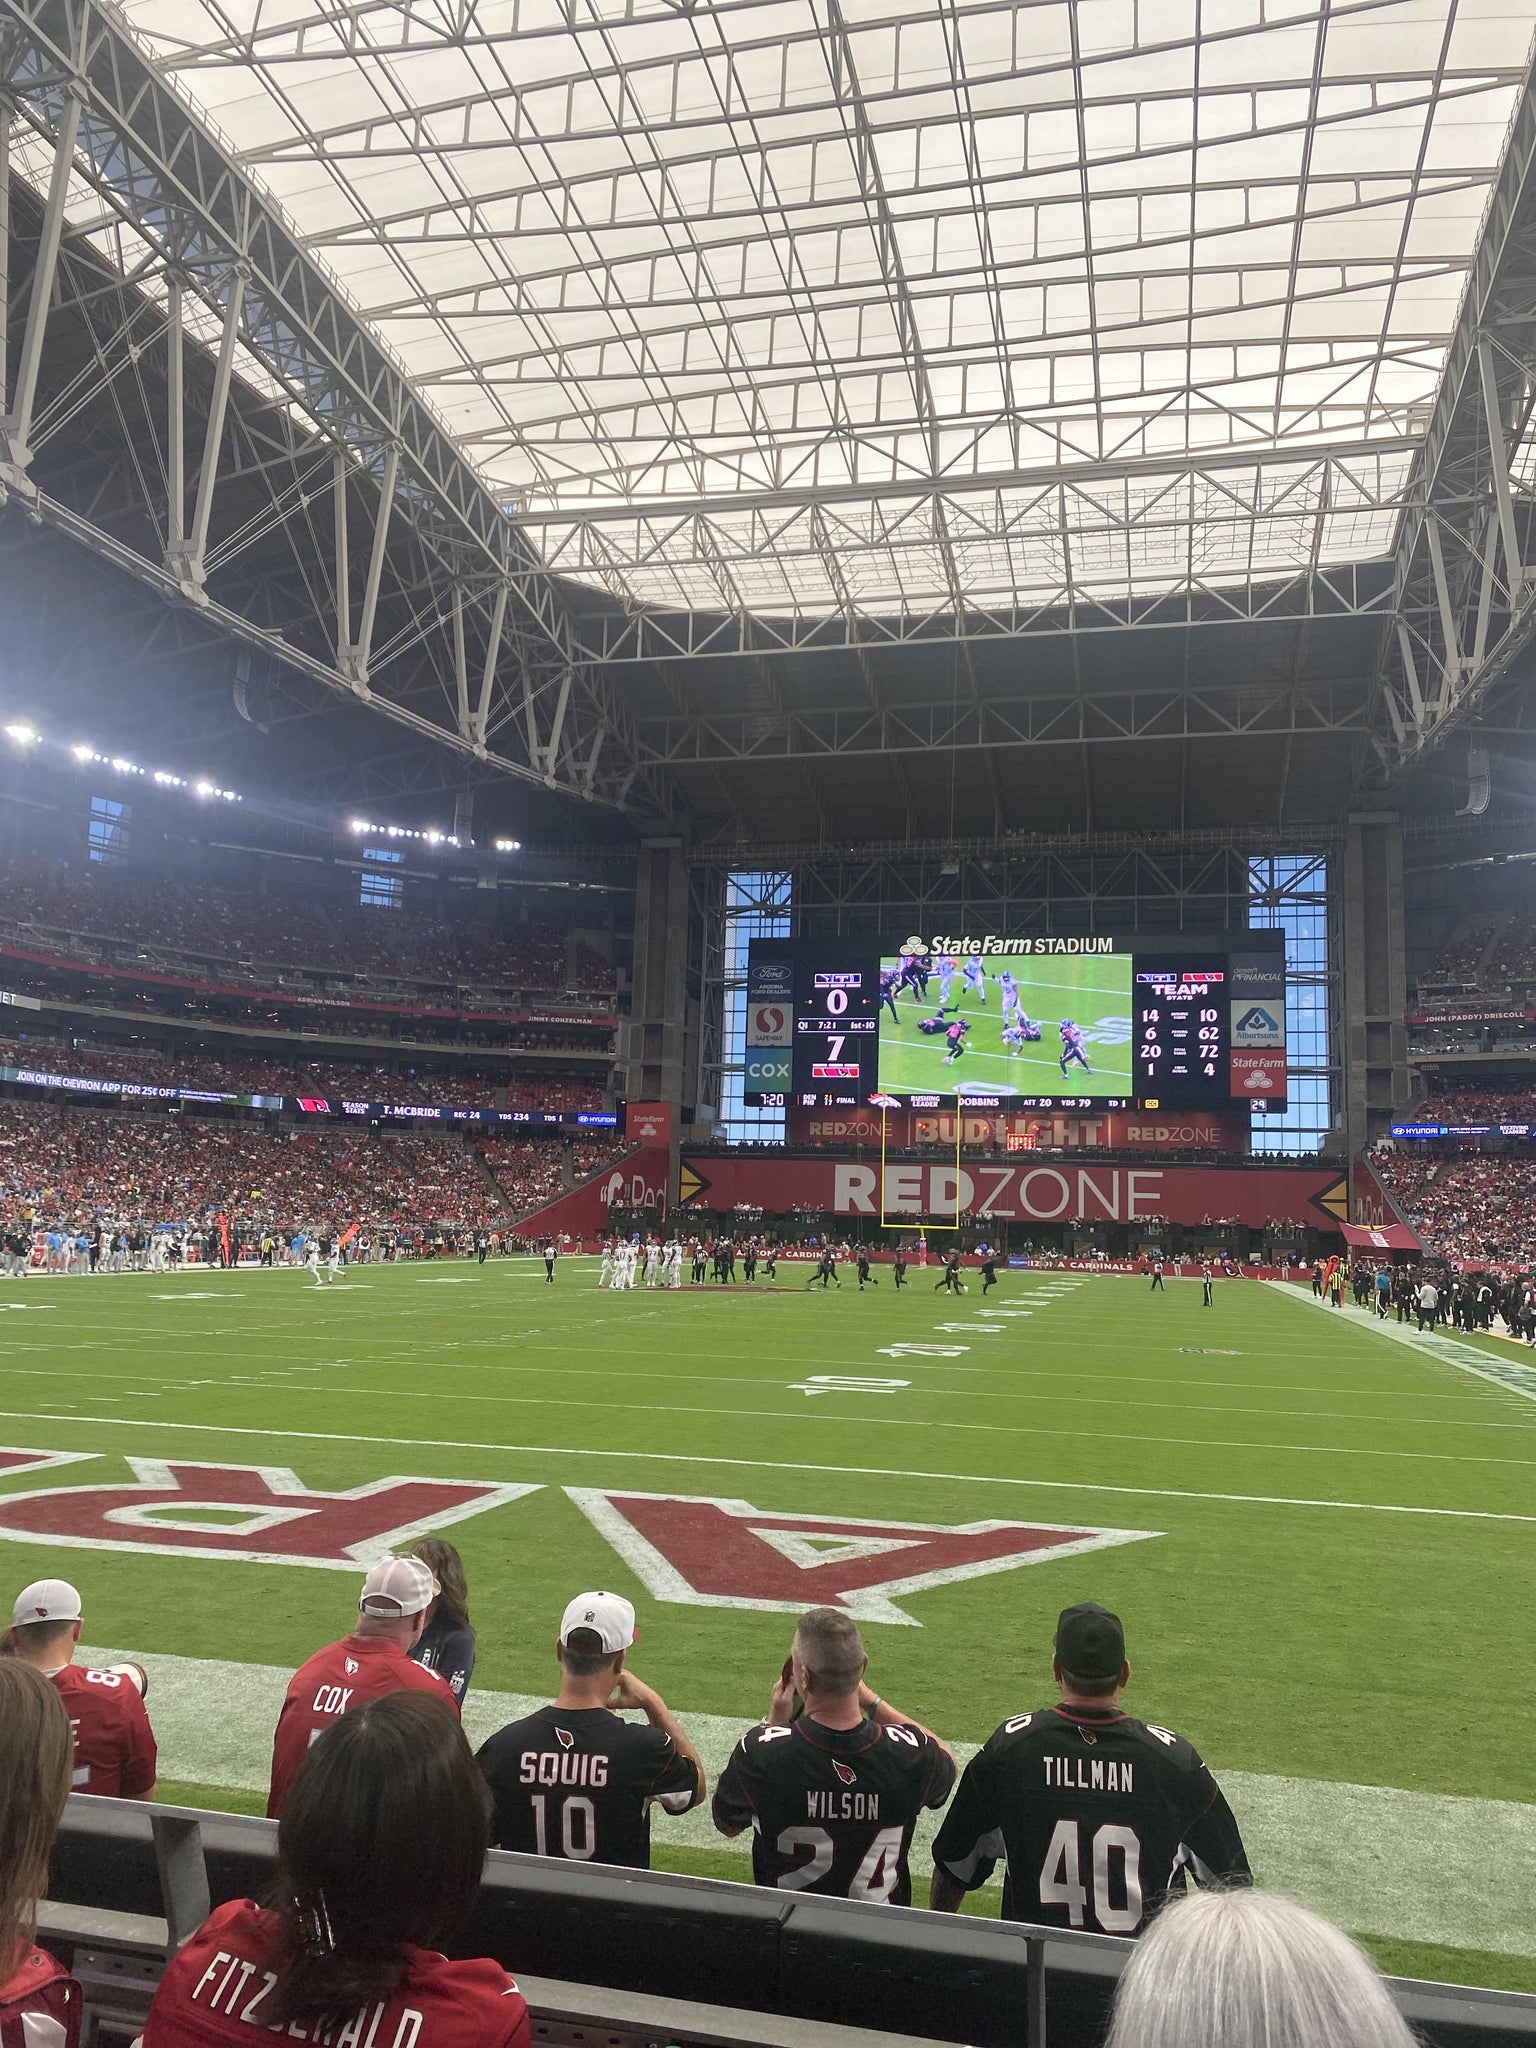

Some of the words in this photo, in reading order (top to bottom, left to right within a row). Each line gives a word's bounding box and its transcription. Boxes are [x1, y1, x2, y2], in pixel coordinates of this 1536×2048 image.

[1035, 937, 1113, 953] STADIUM
[760, 967, 783, 978] Ford
[1152, 984, 1208, 995] TEAM
[826, 989, 848, 1014] 0
[1143, 1009, 1159, 1022] 14
[1200, 1009, 1218, 1022] 10
[1145, 1027, 1157, 1040] 6
[1199, 1027, 1219, 1040] 62
[1236, 1031, 1279, 1039] Albertsons
[827, 1036, 845, 1061] 7
[1141, 1045, 1162, 1058] 20
[1199, 1045, 1219, 1058] 72
[749, 1063, 789, 1078] COX
[1147, 1063, 1154, 1076] 1
[1203, 1062, 1216, 1076] 4
[16, 1070, 35, 1081] JOIN
[35, 1073, 47, 1084] ON
[48, 1075, 61, 1086] THE
[62, 1077, 100, 1091] CHEVRON
[101, 1082, 120, 1093] APP
[122, 1084, 140, 1095] FOR
[158, 1088, 177, 1098] OFF
[342, 1101, 369, 1109] SEASON
[760, 1094, 784, 1105] 7:20
[958, 1097, 999, 1107] DOBBINS
[1023, 1099, 1036, 1107] ATT
[1039, 1098, 1052, 1107] 20
[1061, 1099, 1075, 1107] YDS
[1078, 1099, 1091, 1108] 79
[1108, 1099, 1119, 1107] TD
[1252, 1100, 1266, 1110] 29
[383, 1105, 392, 1115] T.
[394, 1107, 441, 1117] MCBRIDE
[470, 1111, 480, 1119] 24
[513, 1113, 529, 1121] 234
[915, 1117, 990, 1144] BUD
[785, 1375, 913, 1397] 10
[312, 1685, 354, 1715] COX
[520, 1752, 609, 1787] SQUIG
[1043, 1756, 1133, 1793] TILLMAN
[806, 1790, 880, 1821] WILSON
[531, 1795, 595, 1860] 10
[777, 1825, 904, 1905] 24
[1040, 1820, 1143, 1932] 40
